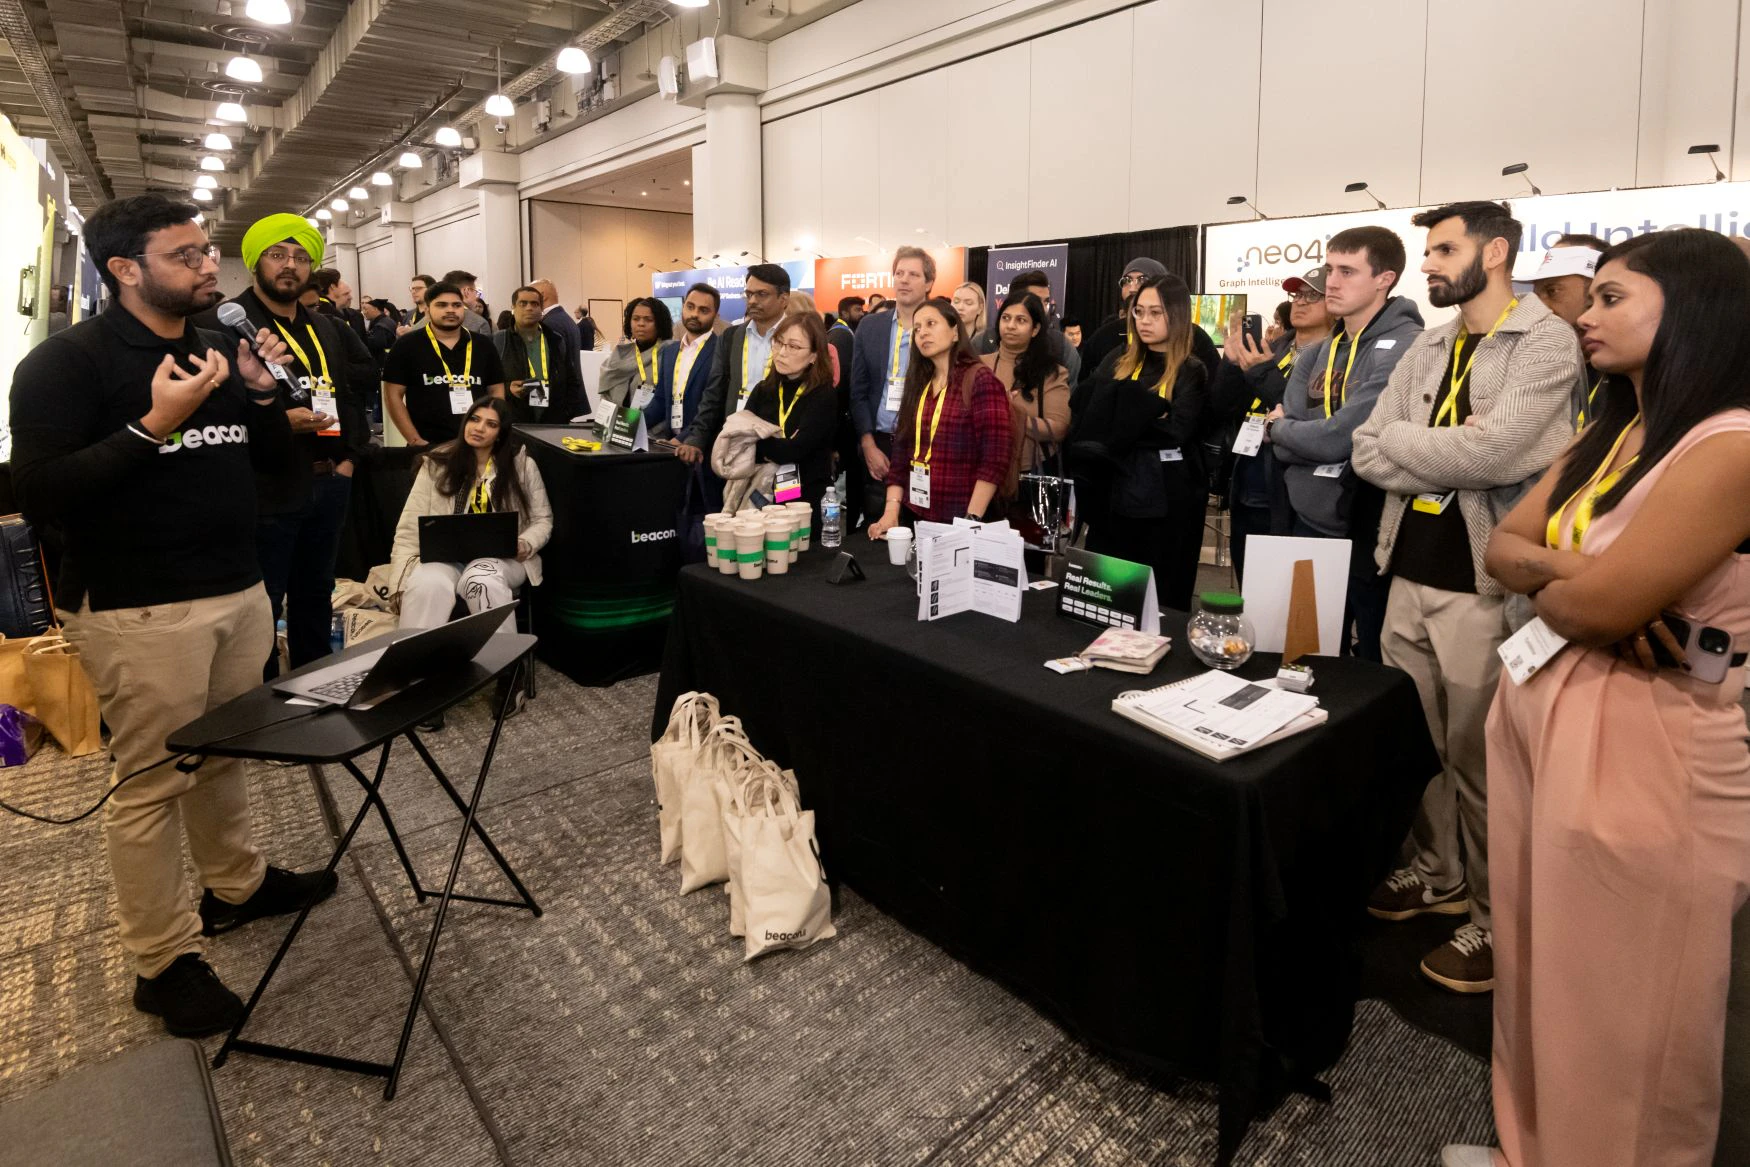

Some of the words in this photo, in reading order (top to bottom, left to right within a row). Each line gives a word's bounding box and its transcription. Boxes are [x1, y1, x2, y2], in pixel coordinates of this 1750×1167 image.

[1245, 234, 1331, 265] neo4
[1049, 258, 1058, 268] AI
[841, 271, 895, 290] FORTI
[1219, 279, 1246, 288] Graph
[1065, 571, 1082, 583] Real
[1064, 581, 1081, 593] Real
